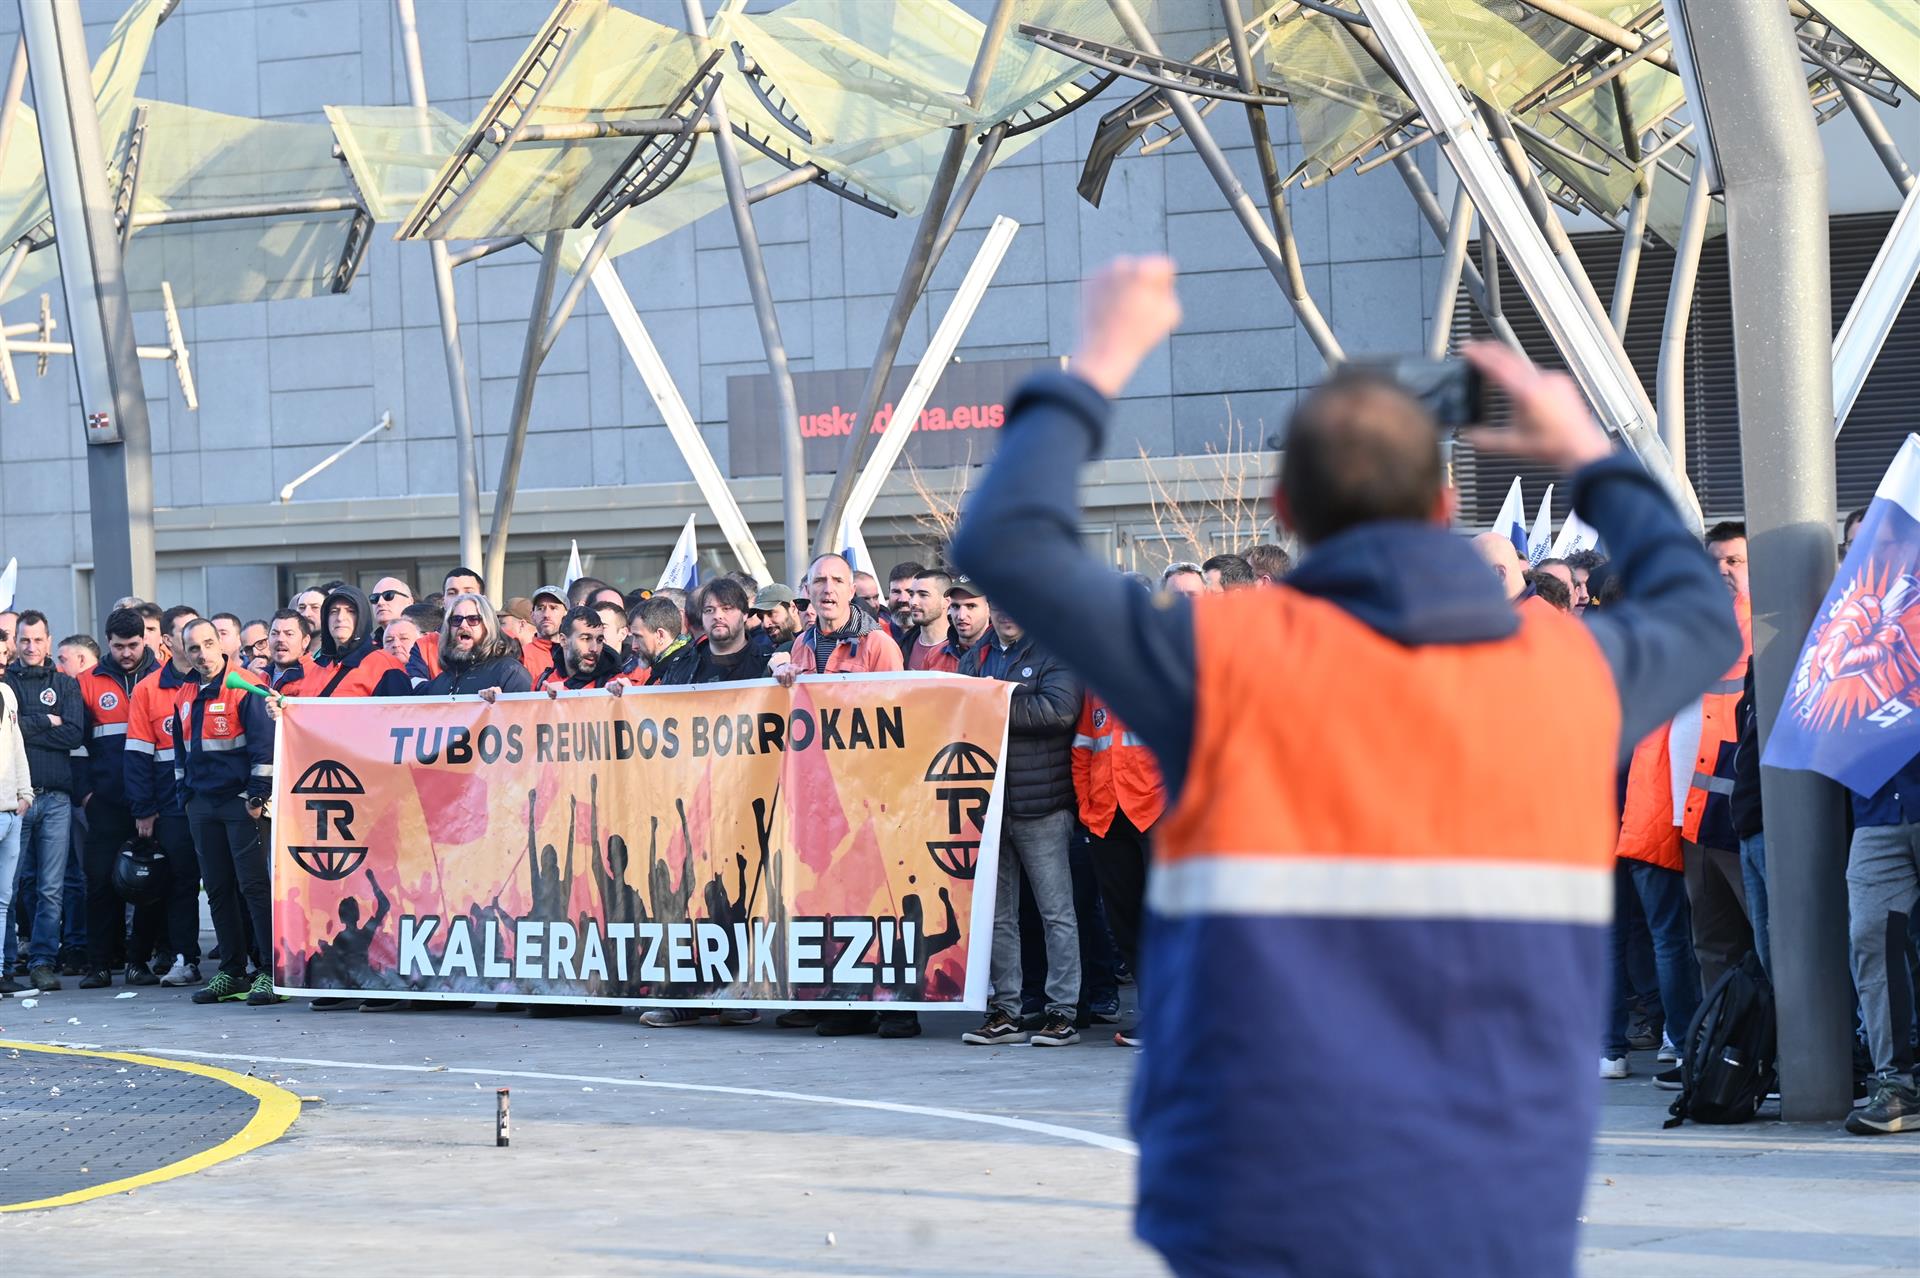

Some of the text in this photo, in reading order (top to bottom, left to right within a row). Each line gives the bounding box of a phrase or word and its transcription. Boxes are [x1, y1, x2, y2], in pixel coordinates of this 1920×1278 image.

[390, 706, 905, 765] TUBOS REUNIDOS BORROKAN
[306, 800, 356, 841] TR
[936, 787, 991, 834] TR
[400, 919, 917, 984] KALERATZERIK EZ!!
